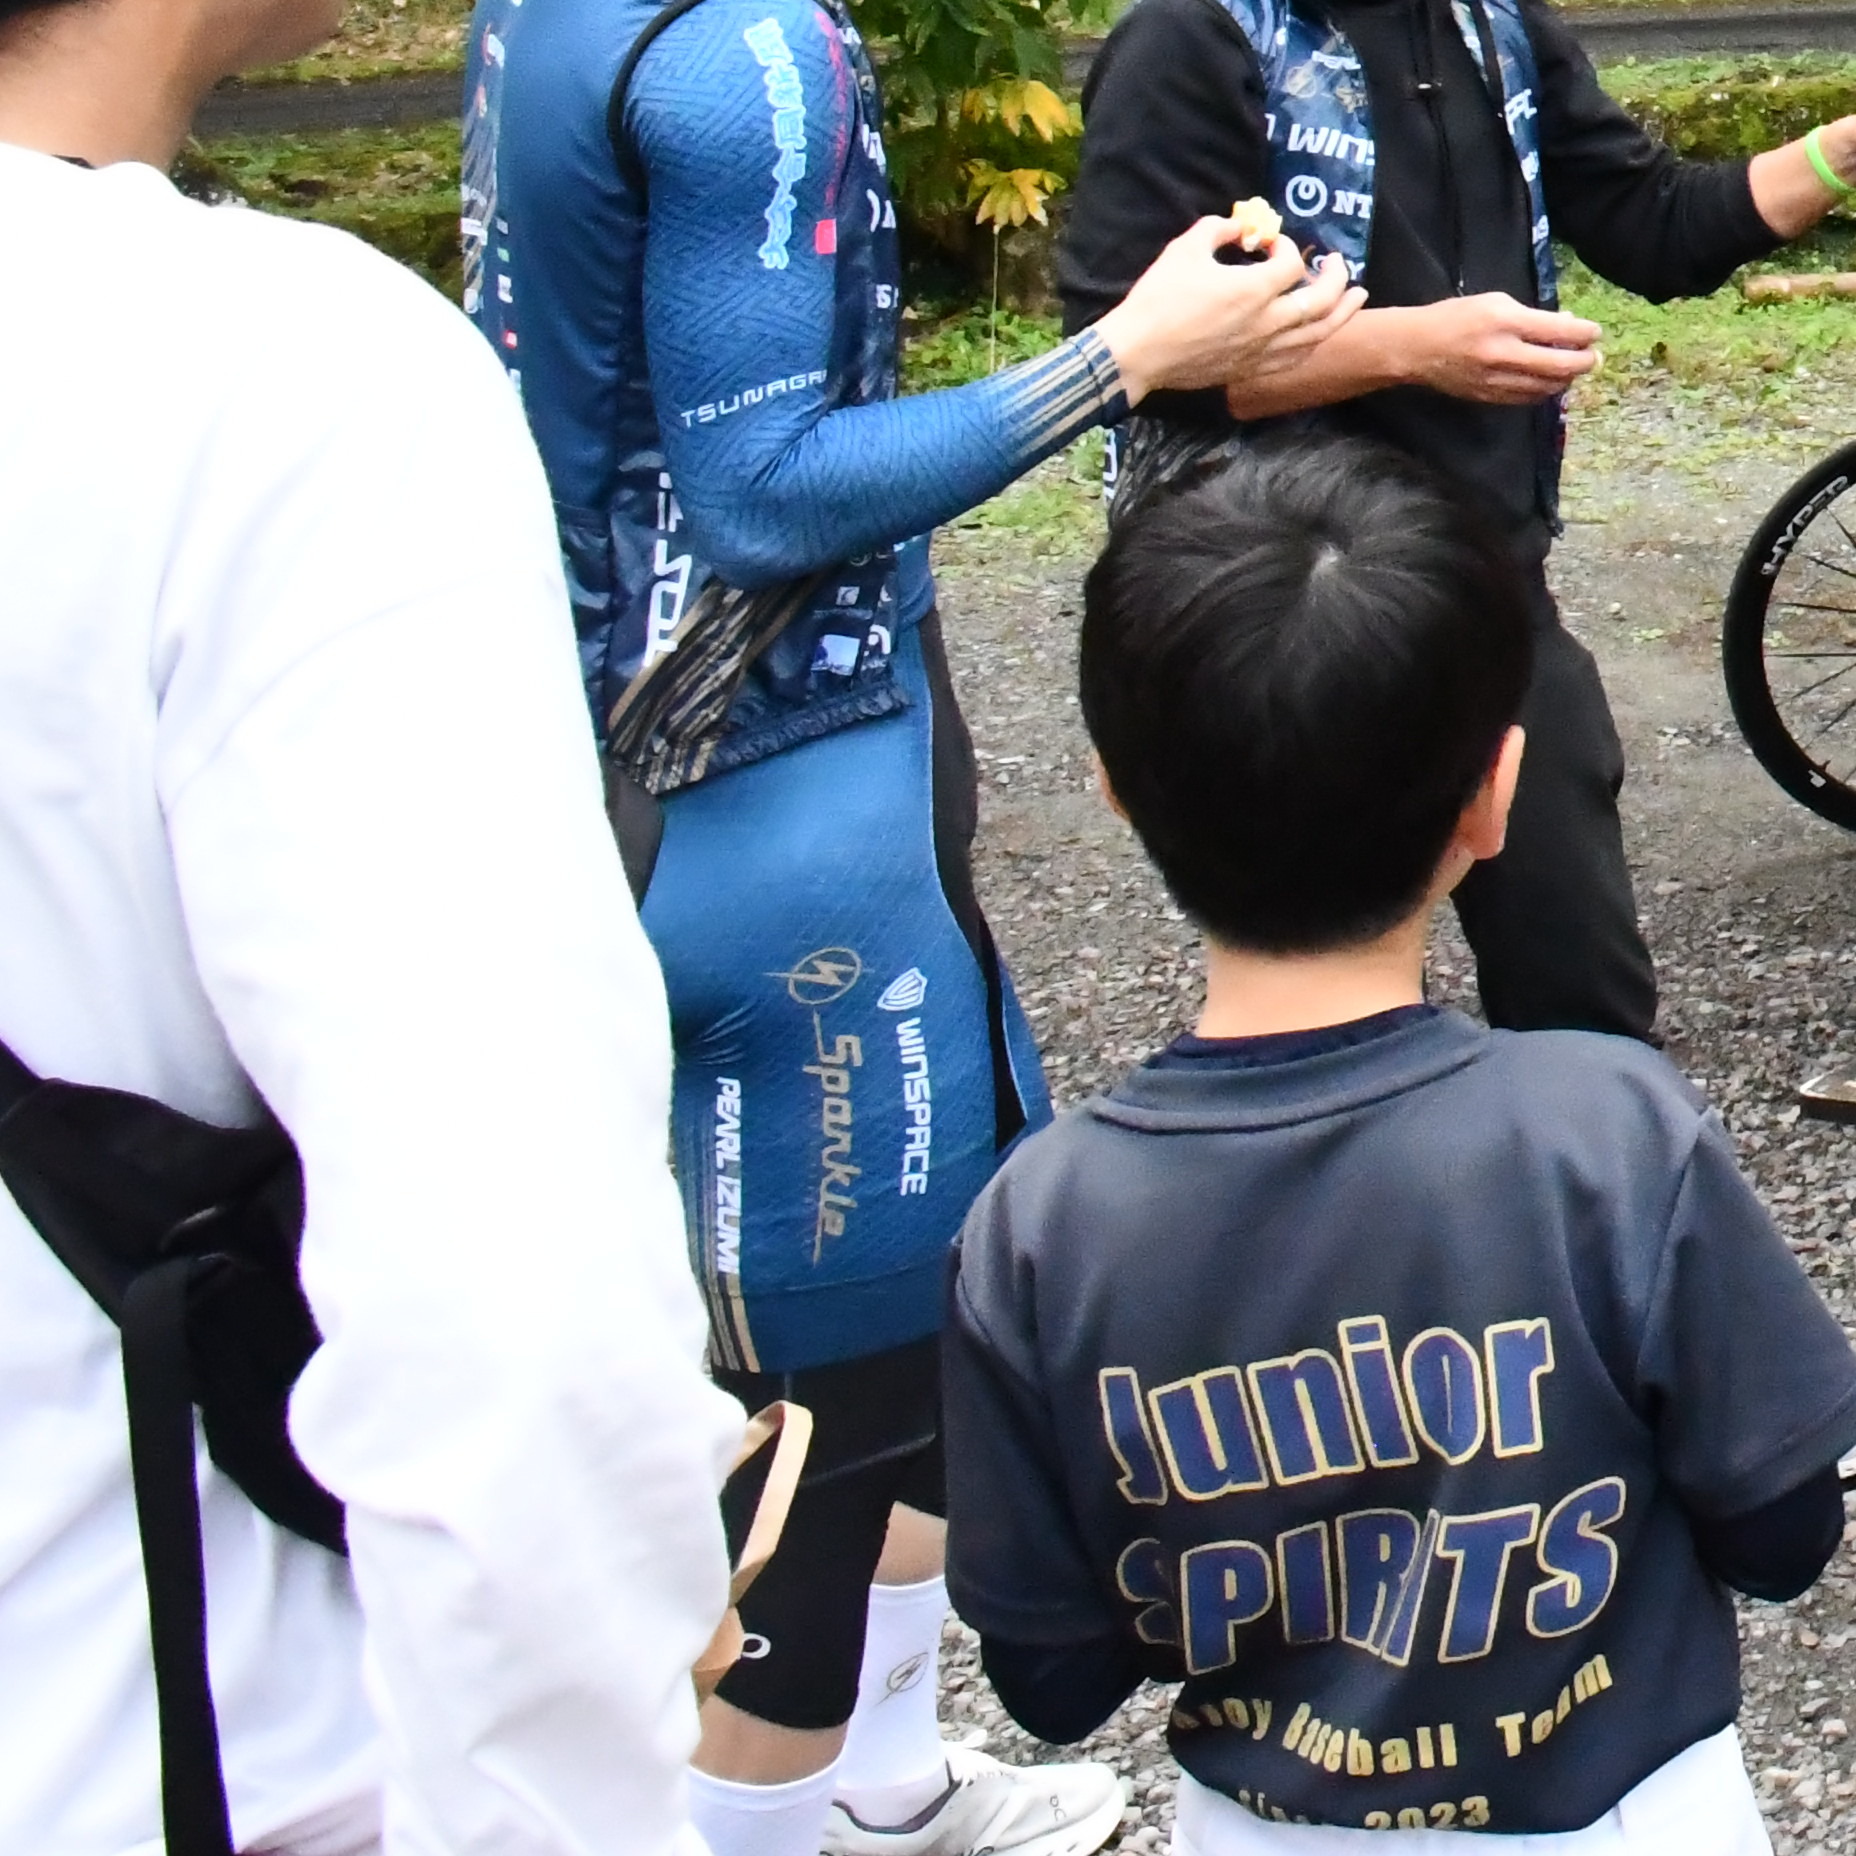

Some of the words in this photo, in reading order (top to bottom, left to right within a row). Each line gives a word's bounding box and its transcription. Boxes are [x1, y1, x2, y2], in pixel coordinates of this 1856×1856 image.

[680, 368, 828, 429] TSUNAGA
[896, 1015, 933, 1197] WINSPACE
[715, 1173, 742, 1275] IZUMI
[1098, 1314, 1556, 1507] Junior
[1282, 1701, 1458, 1778] Baseball
[1494, 1653, 1614, 1759] Team
